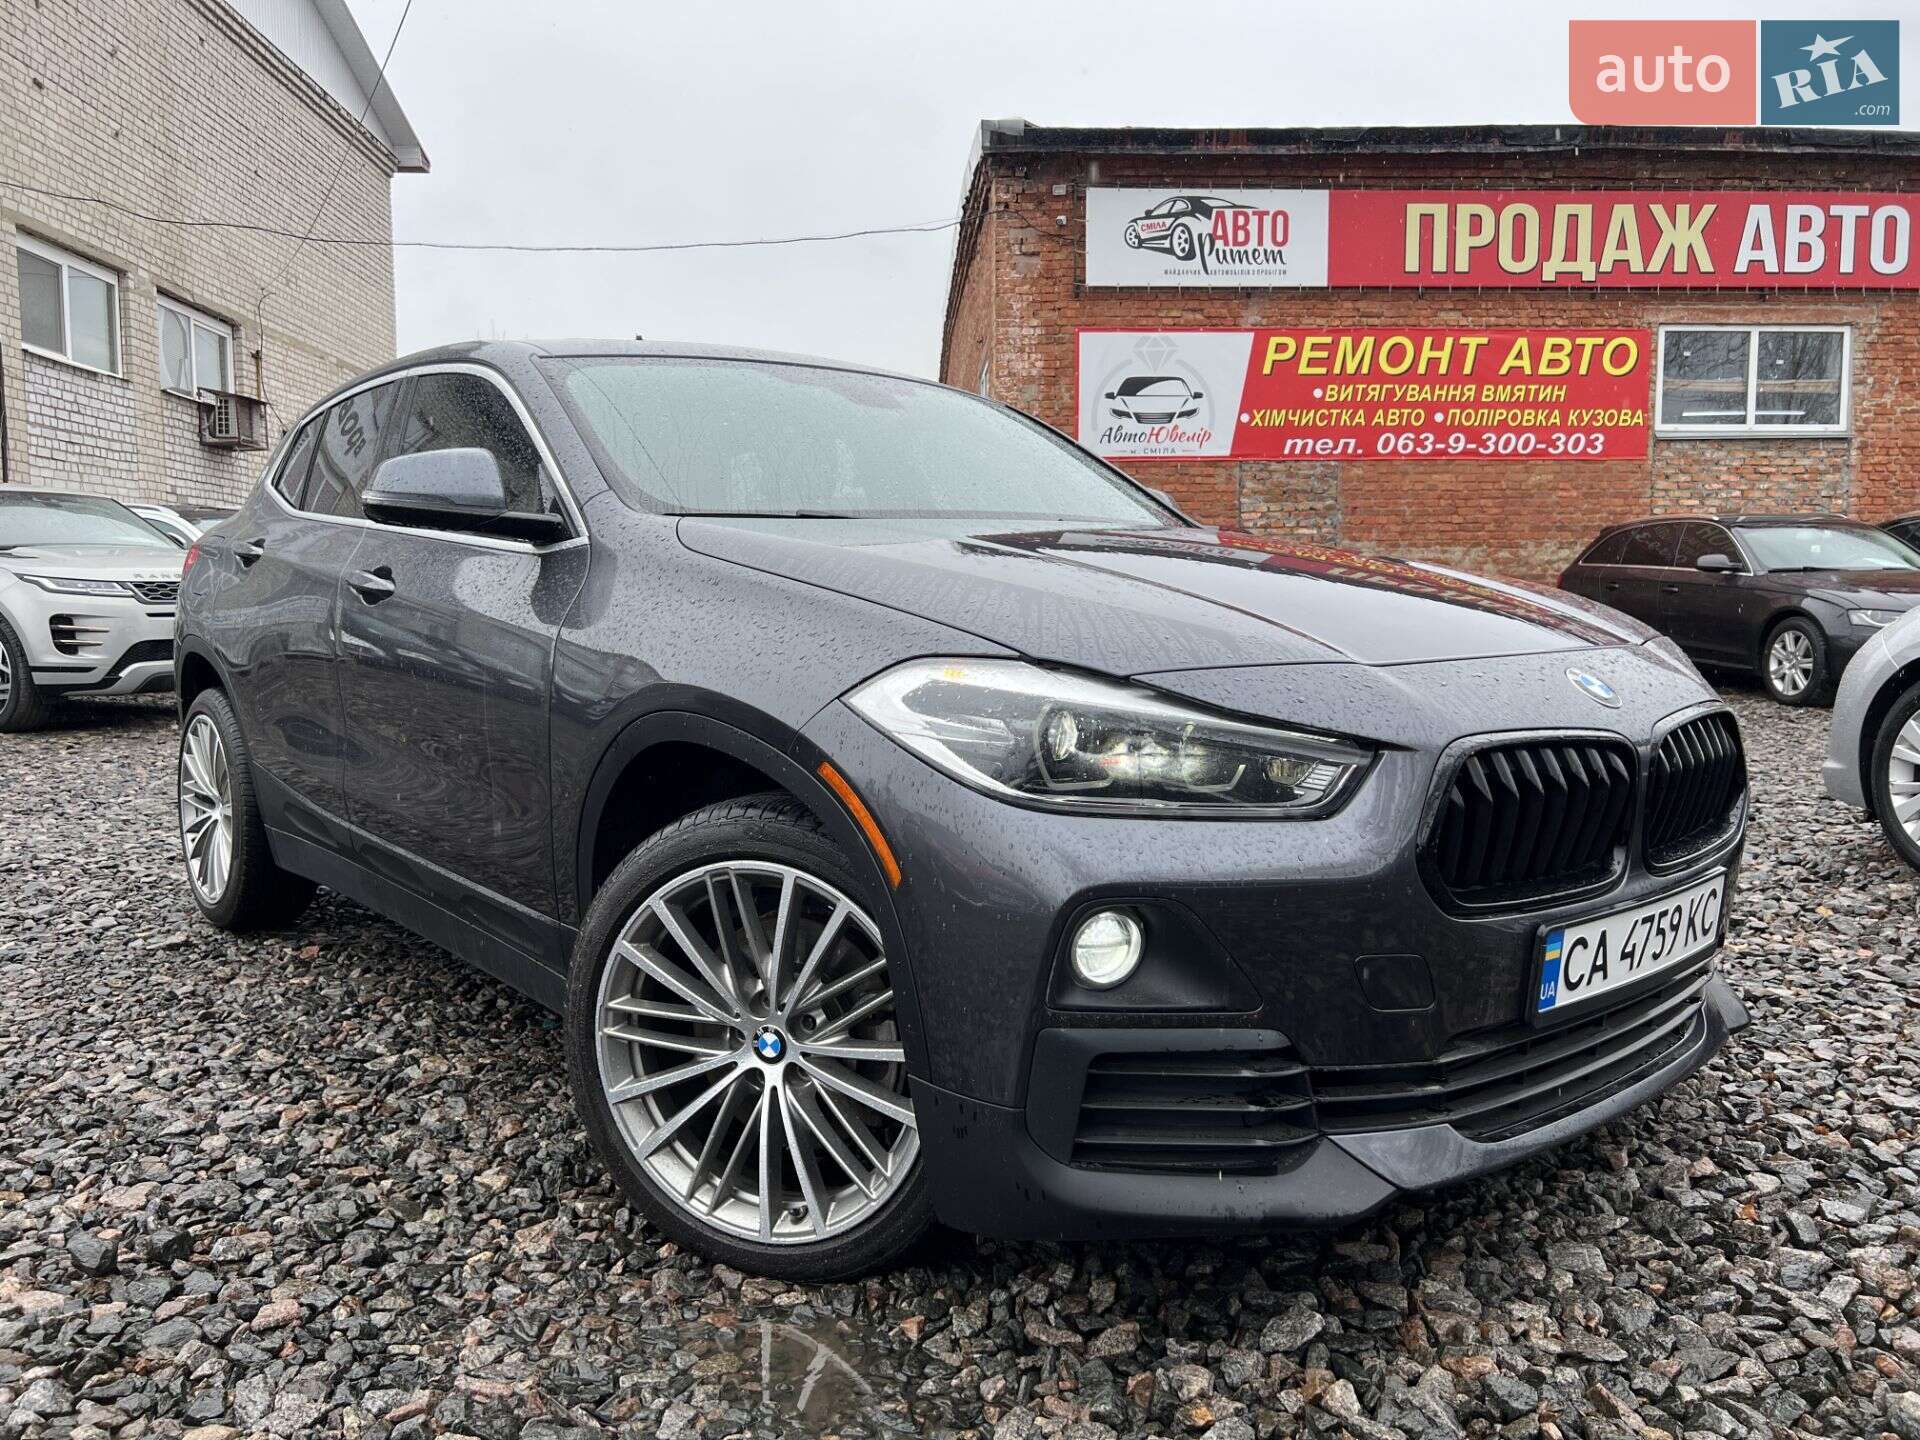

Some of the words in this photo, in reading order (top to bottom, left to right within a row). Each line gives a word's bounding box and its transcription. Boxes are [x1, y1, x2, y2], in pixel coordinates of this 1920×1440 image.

[1212, 210, 1289, 247] АВТО
[1403, 202, 1718, 283] ПРОДАЖ
[1733, 203, 1911, 276] АВТО
[1262, 335, 1489, 376] РЕМОНТ
[1499, 336, 1640, 377] АВТО
[1325, 384, 1477, 402] ВИТЯГУВАННЯ
[1481, 384, 1567, 402] ВМЯТИН
[1250, 408, 1367, 427] ХІМЧИСТКА
[1371, 408, 1426, 427] АВТО
[1446, 408, 1561, 427] ПОЛІРОВКА
[1567, 408, 1645, 427] КУЗОВА
[1376, 432, 1606, 455] 063-9-300-303
[1563, 928, 1608, 991] CA
[1619, 904, 1683, 972] 4759
[1684, 888, 1718, 947] KC
[1540, 983, 1556, 1000] UA
